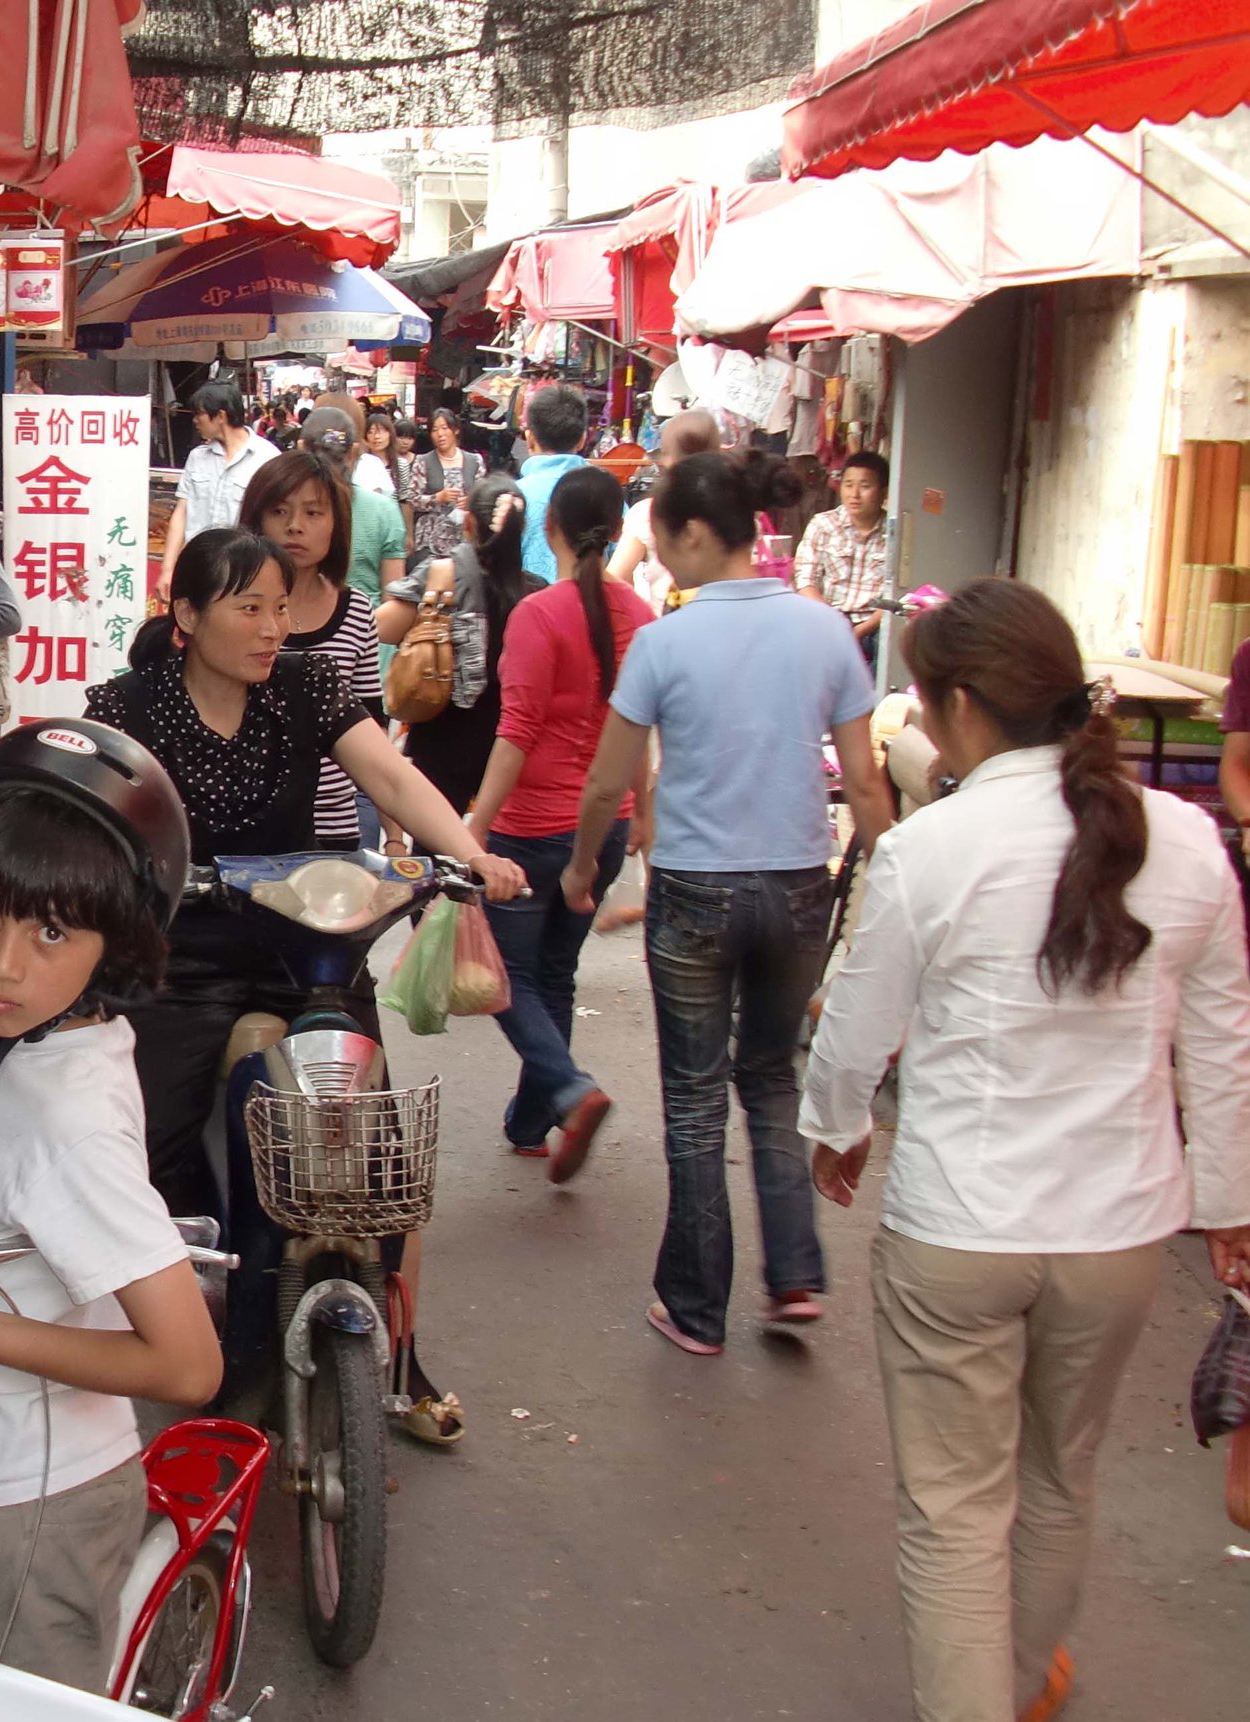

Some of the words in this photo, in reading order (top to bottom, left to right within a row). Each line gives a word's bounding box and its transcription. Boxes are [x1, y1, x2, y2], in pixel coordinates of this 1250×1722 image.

[14, 408, 140, 446] 高价回收
[13, 455, 92, 724] 金银加
[104, 516, 137, 677] 无痛穿
[46, 732, 85, 749] BELL
